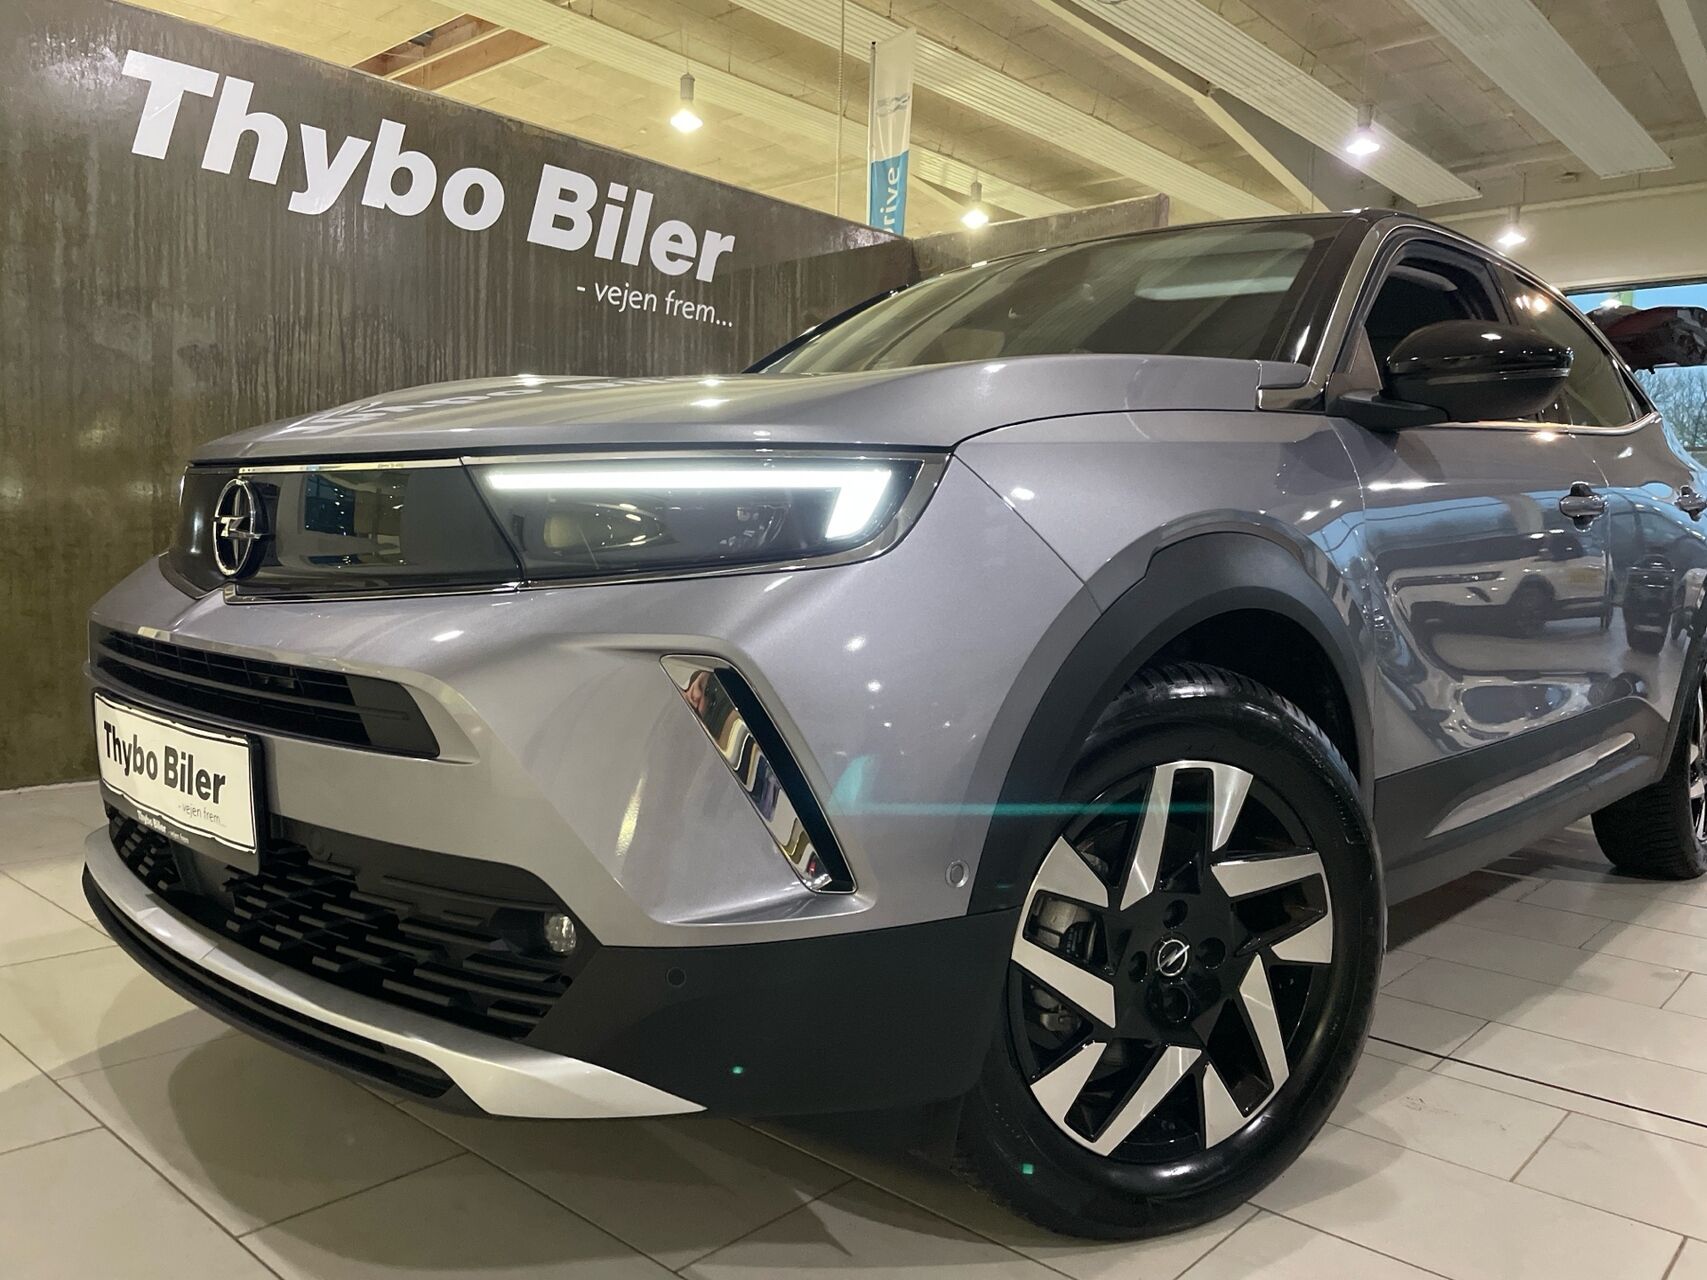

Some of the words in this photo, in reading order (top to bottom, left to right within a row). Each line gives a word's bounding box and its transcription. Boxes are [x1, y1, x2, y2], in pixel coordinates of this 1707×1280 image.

[122, 50, 505, 231] Thybo
[527, 163, 735, 282] Biler
[594, 282, 658, 313] vejen
[665, 290, 733, 327] frem...
[103, 720, 158, 781] Thybo
[164, 745, 226, 805] Biler
